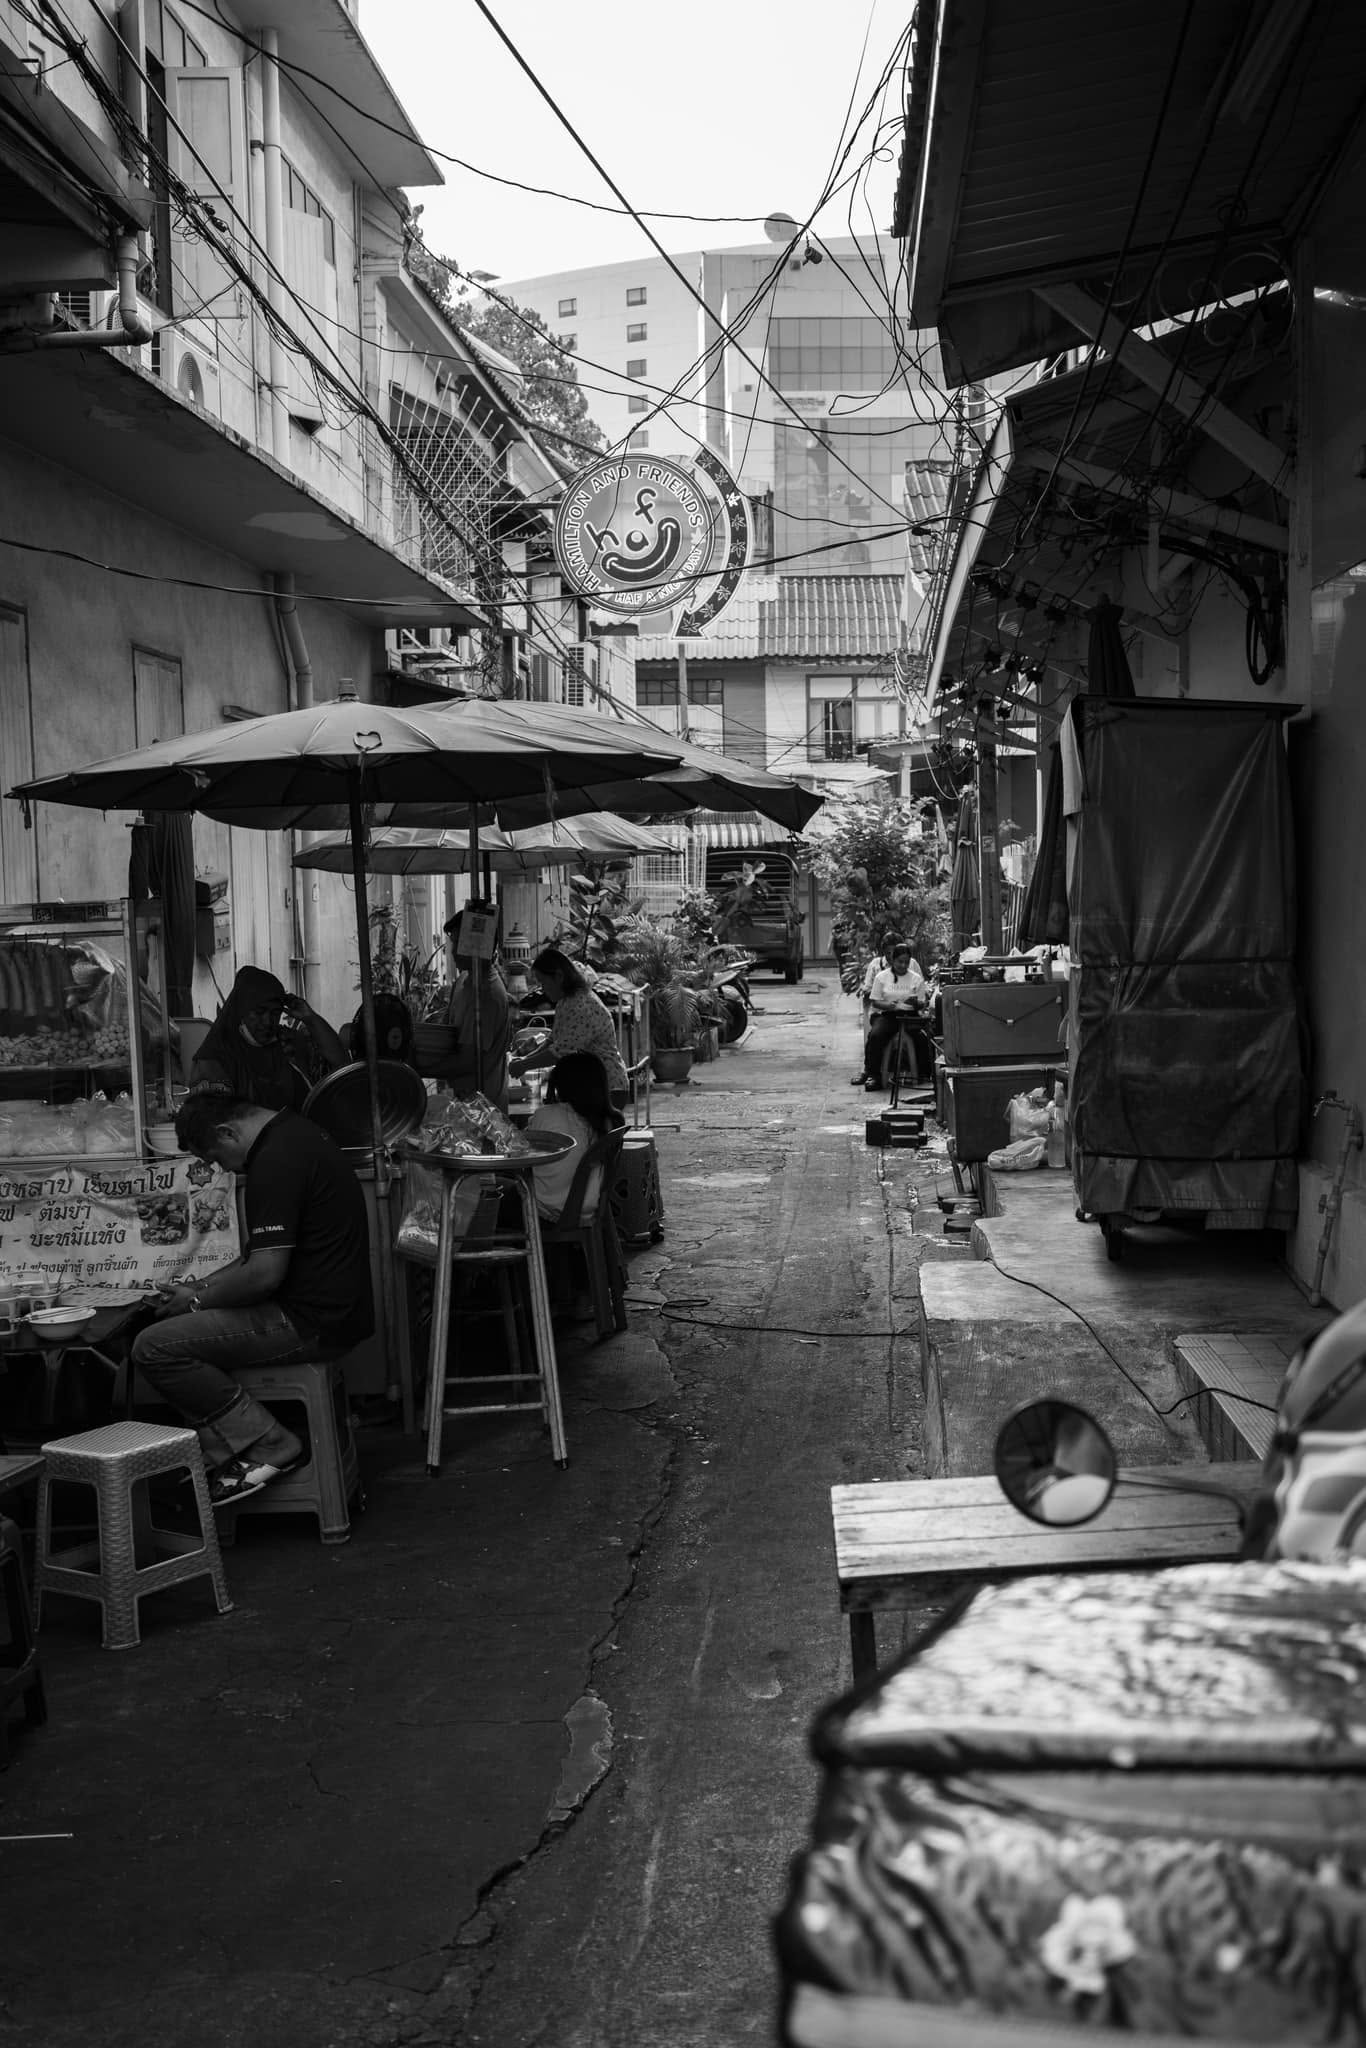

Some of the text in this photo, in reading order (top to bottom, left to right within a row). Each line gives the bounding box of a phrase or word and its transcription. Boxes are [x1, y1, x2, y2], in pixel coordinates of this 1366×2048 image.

[564, 464, 704, 592] HAMILTON AND FRIENDS
